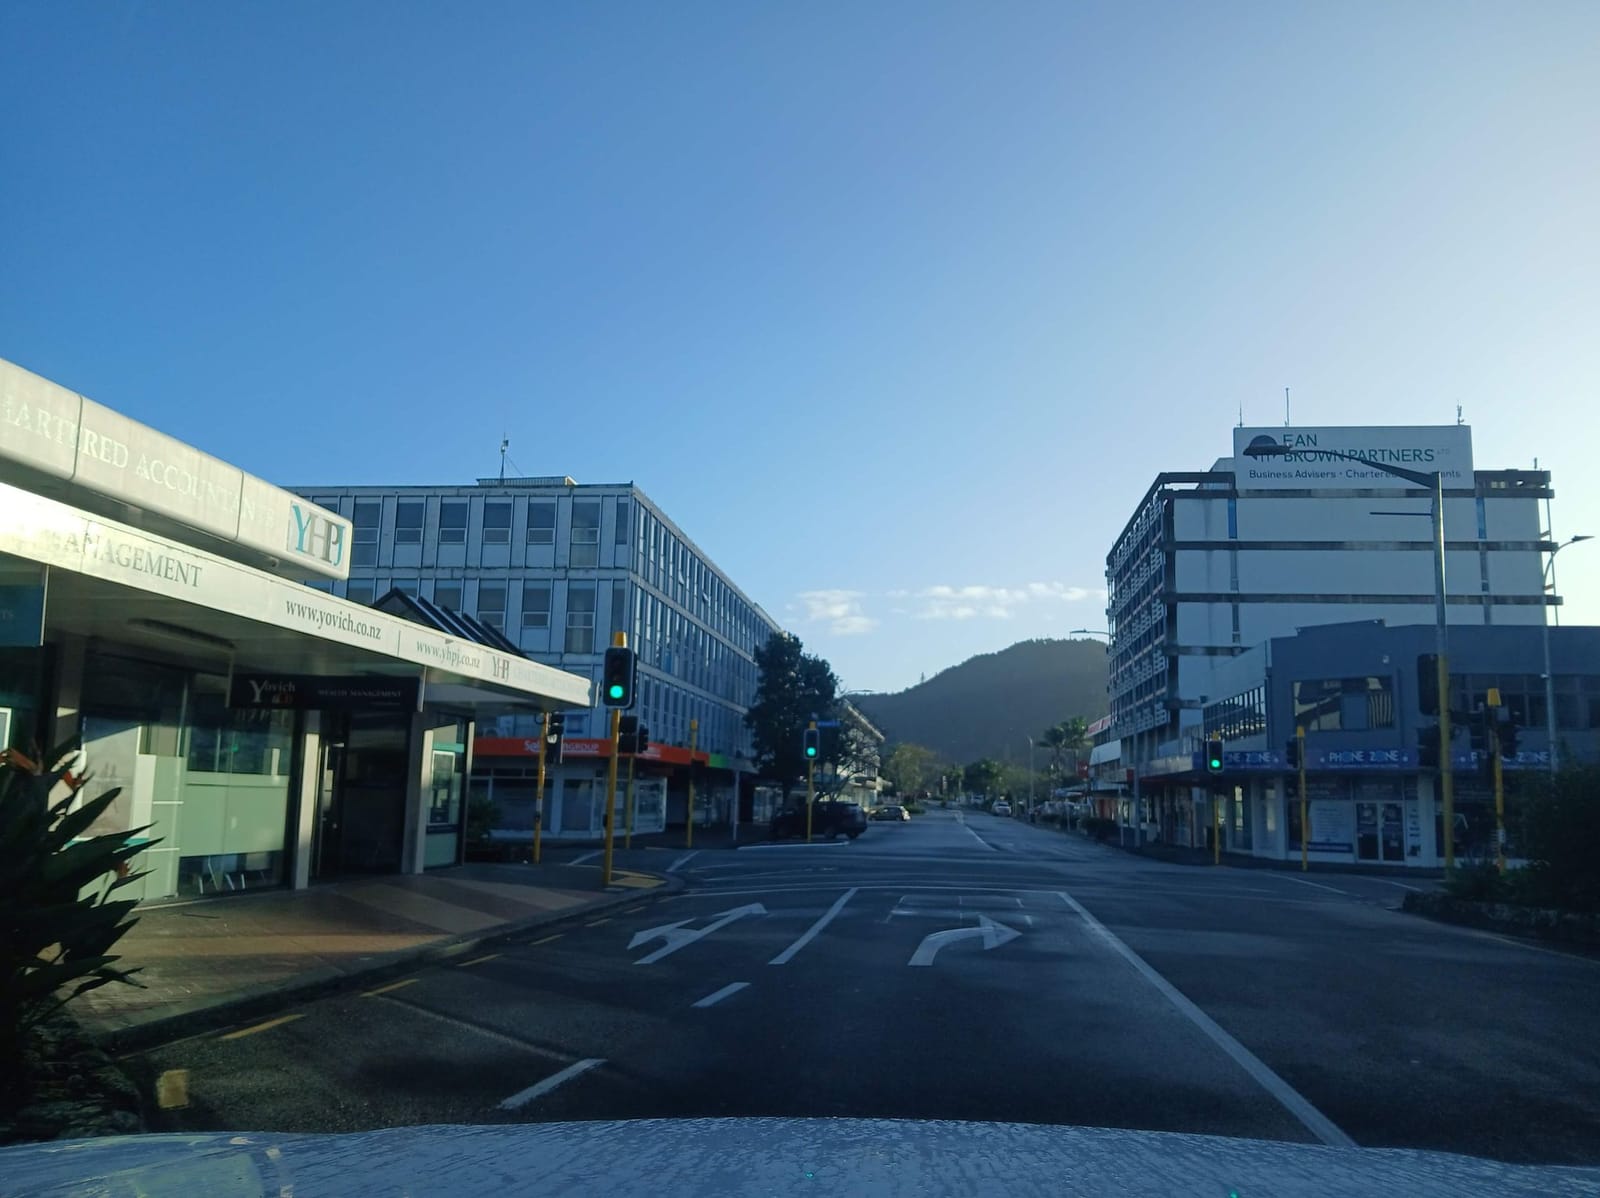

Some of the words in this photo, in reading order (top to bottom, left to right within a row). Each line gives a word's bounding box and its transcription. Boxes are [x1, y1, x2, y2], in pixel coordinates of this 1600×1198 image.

[3, 396, 129, 469] ARTERED
[1284, 448, 1344, 462] BROWN
[1349, 448, 1435, 462] PARTNERS
[1249, 469, 1293, 479] Business
[1295, 469, 1337, 479] Advisers
[292, 504, 346, 567] YHPJ
[40, 528, 202, 587] ANAGEMENT
[285, 600, 382, 640] www.yovich.co.nz
[248, 679, 296, 702] Yovich
[1329, 751, 1365, 762] PHONE
[1369, 750, 1400, 762] ZONE
